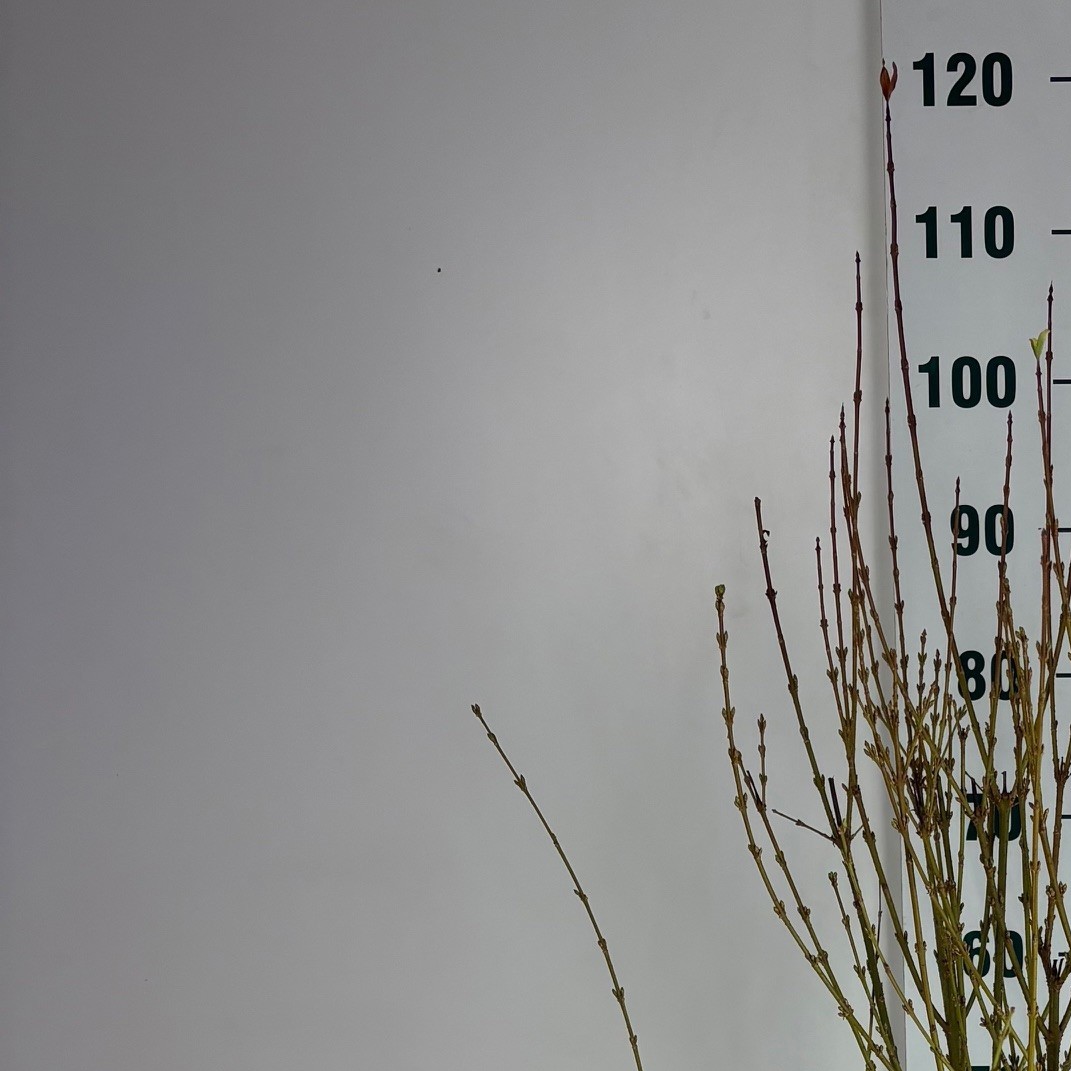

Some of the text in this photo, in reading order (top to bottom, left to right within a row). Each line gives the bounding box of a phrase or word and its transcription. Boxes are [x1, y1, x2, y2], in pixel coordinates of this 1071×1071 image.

[912, 52, 1013, 107] 120
[915, 205, 1015, 259] 110
[918, 356, 1016, 408] 100
[950, 504, 1015, 556] 90
[957, 650, 1019, 700] 80
